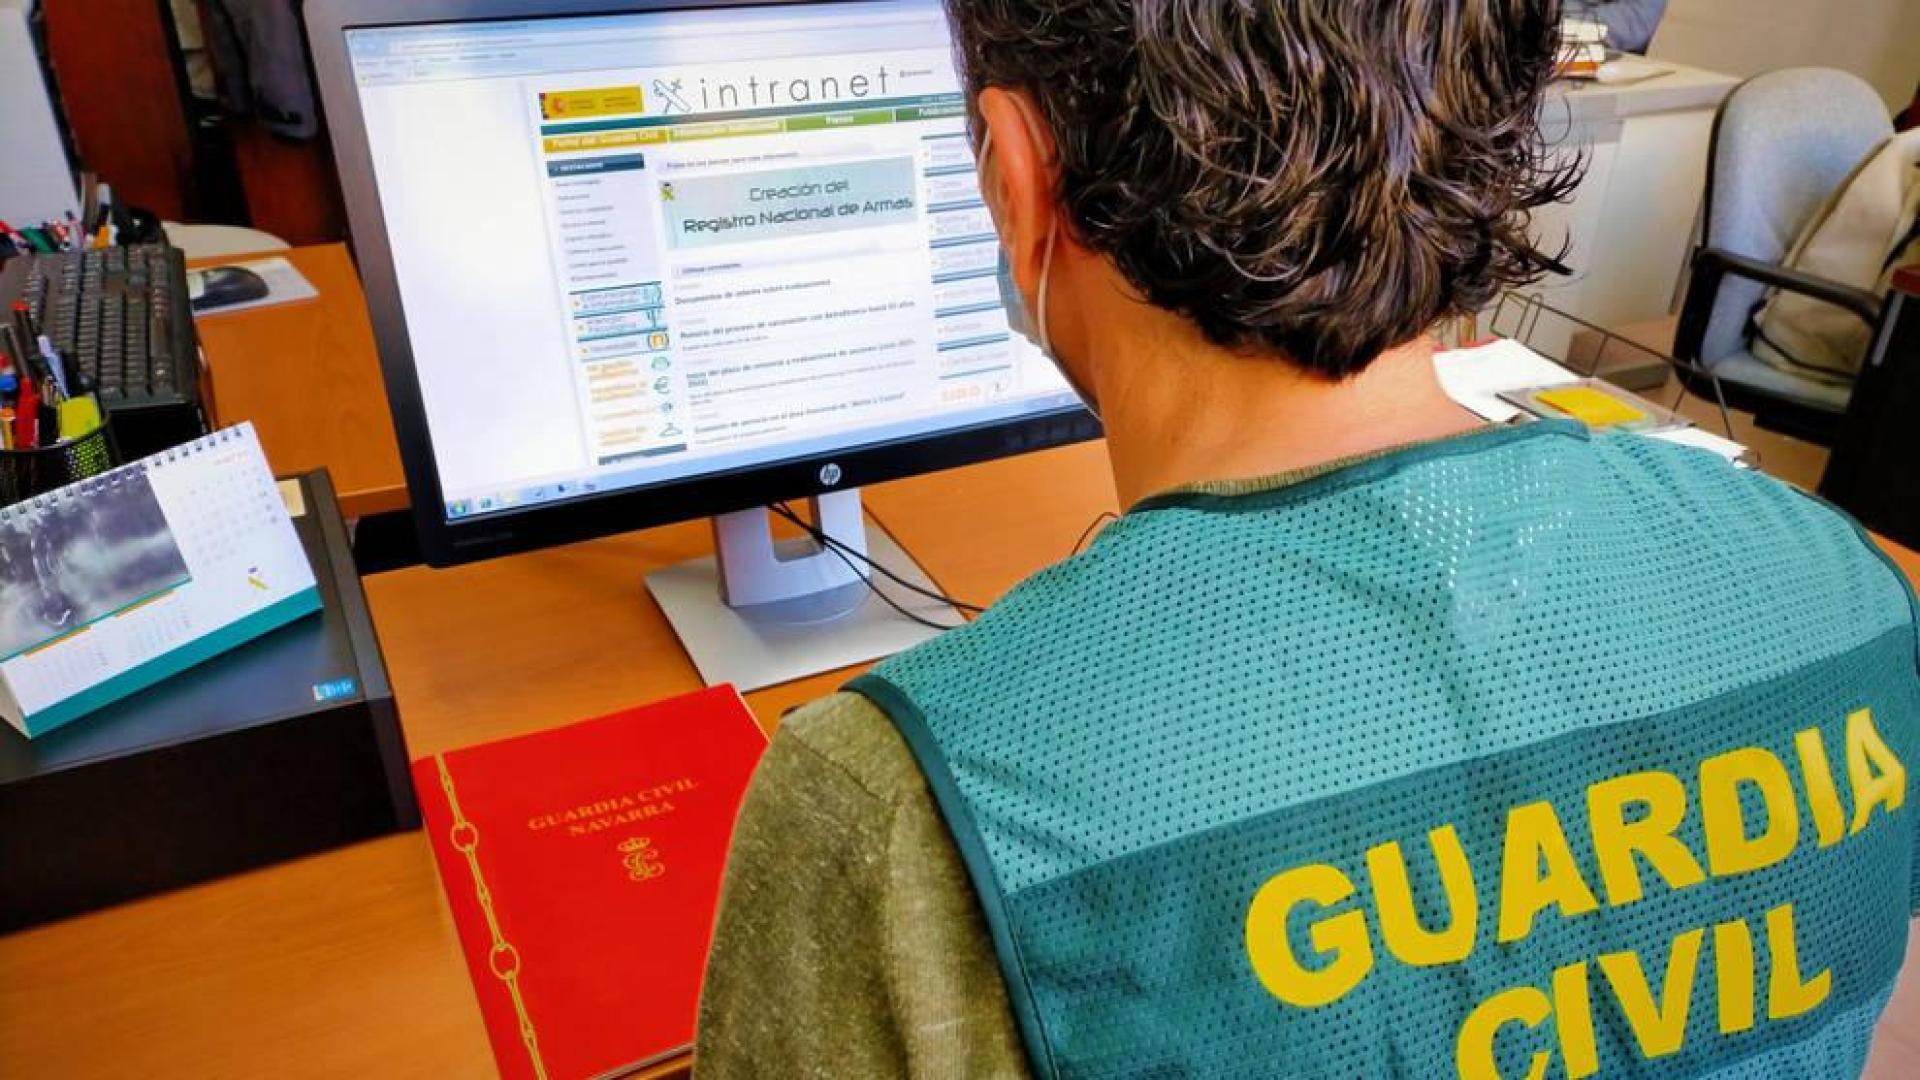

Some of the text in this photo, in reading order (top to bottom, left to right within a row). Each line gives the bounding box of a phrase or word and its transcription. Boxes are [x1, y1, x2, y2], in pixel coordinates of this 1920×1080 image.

[700, 66, 888, 109] intranet
[749, 179, 849, 201] Creación del
[683, 197, 913, 234] Registro Nacional de Armas
[820, 463, 841, 485] hp
[527, 778, 699, 831] GUARDIA CIVIL
[568, 800, 676, 836] NAVARRA
[1245, 707, 1906, 1009] GUARDIA
[1456, 902, 1832, 1080] CIVIL
